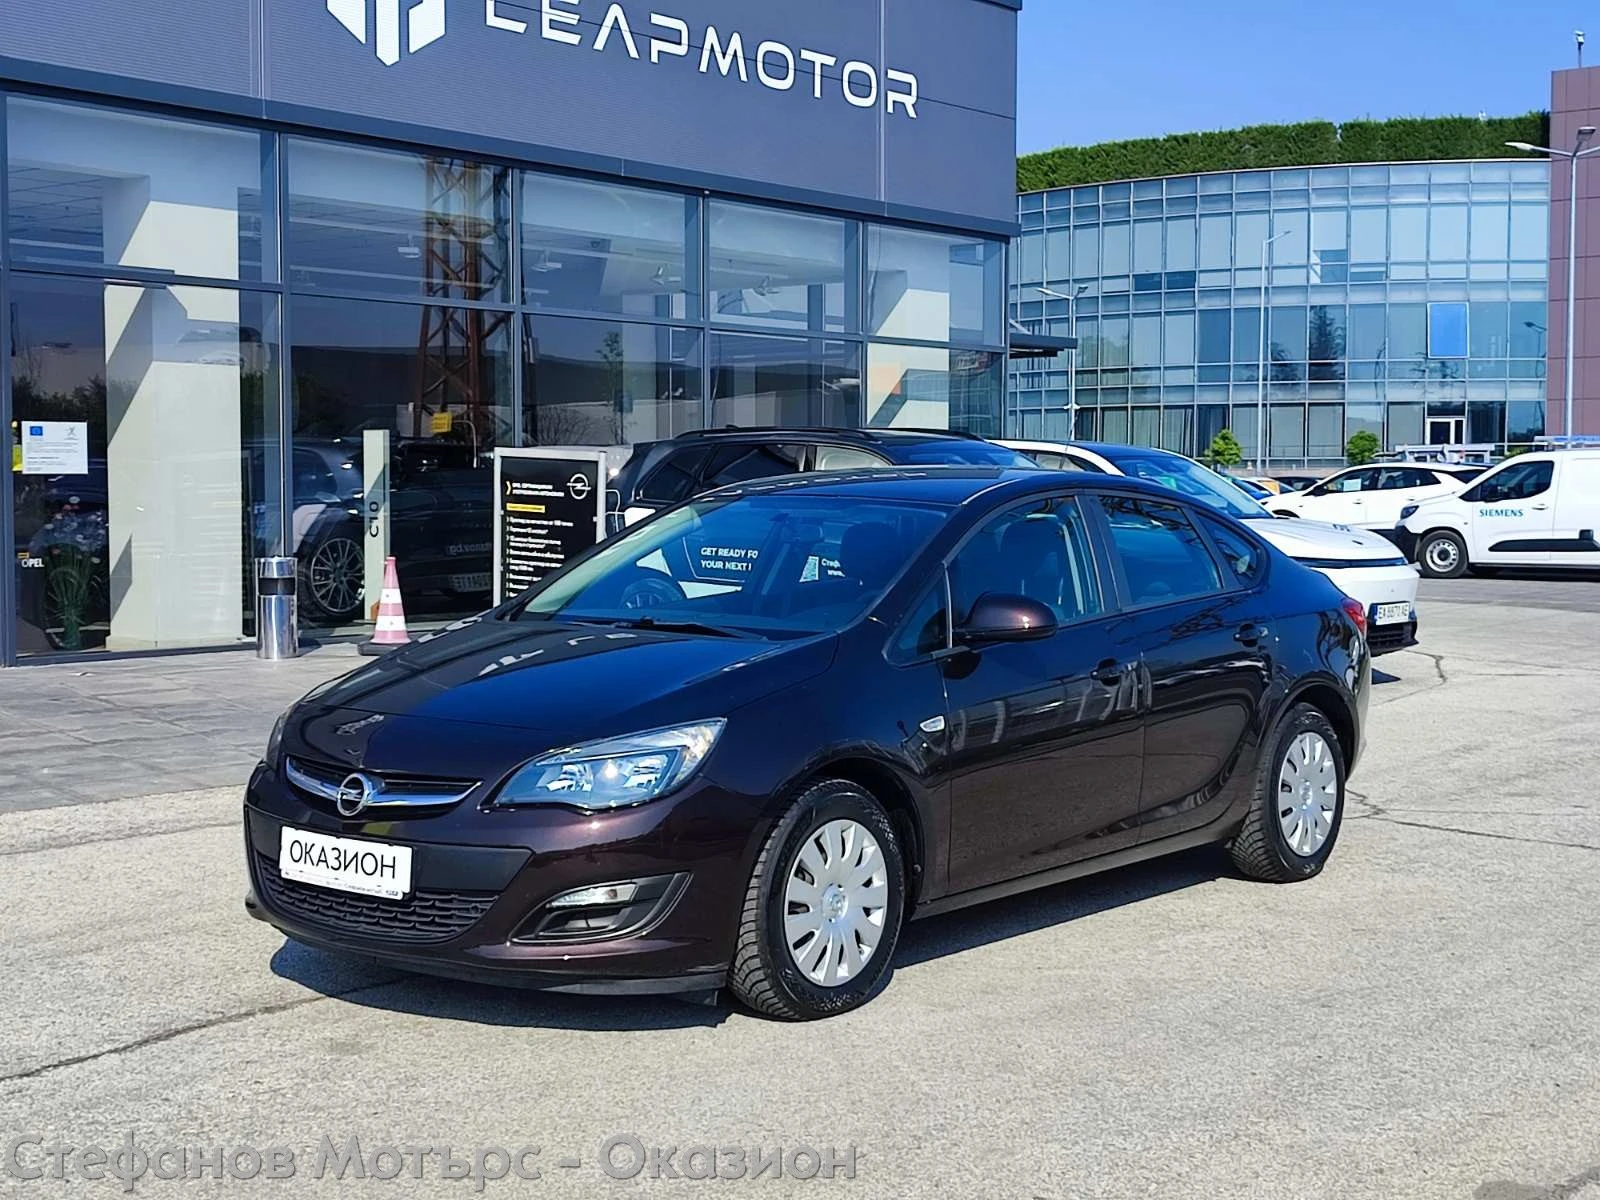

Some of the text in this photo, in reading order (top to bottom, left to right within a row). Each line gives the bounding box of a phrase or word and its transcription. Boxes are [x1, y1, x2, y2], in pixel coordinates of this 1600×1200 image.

[485, 0, 918, 119] LEAPMOTOR
[1479, 508, 1524, 517] SIEMENS
[701, 548, 717, 556] GET
[718, 548, 746, 558] READY
[21, 558, 45, 568] OPEL
[701, 560, 723, 569] YOUR
[725, 561, 747, 571] NEXT
[289, 839, 396, 879] ОКАЗИОН
